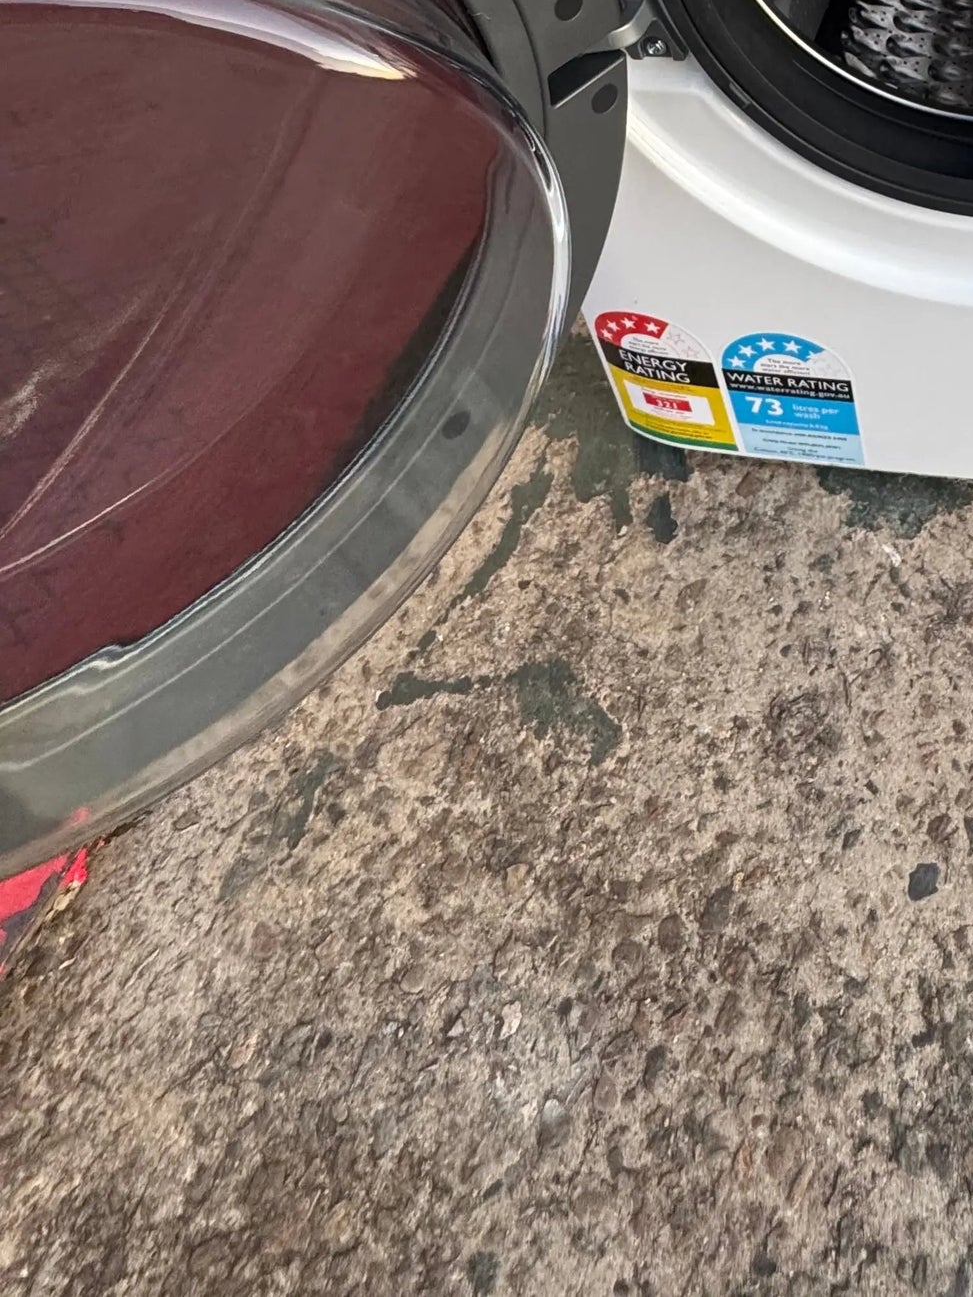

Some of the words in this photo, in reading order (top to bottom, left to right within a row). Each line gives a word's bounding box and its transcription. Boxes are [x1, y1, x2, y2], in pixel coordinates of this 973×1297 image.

[618, 349, 688, 373] ENERGY
[625, 361, 691, 384] RATING
[726, 372, 784, 387] WATER
[787, 377, 850, 393] RATING
[729, 382, 850, 399] www.waterrating.gov.au
[745, 396, 784, 416] 73
